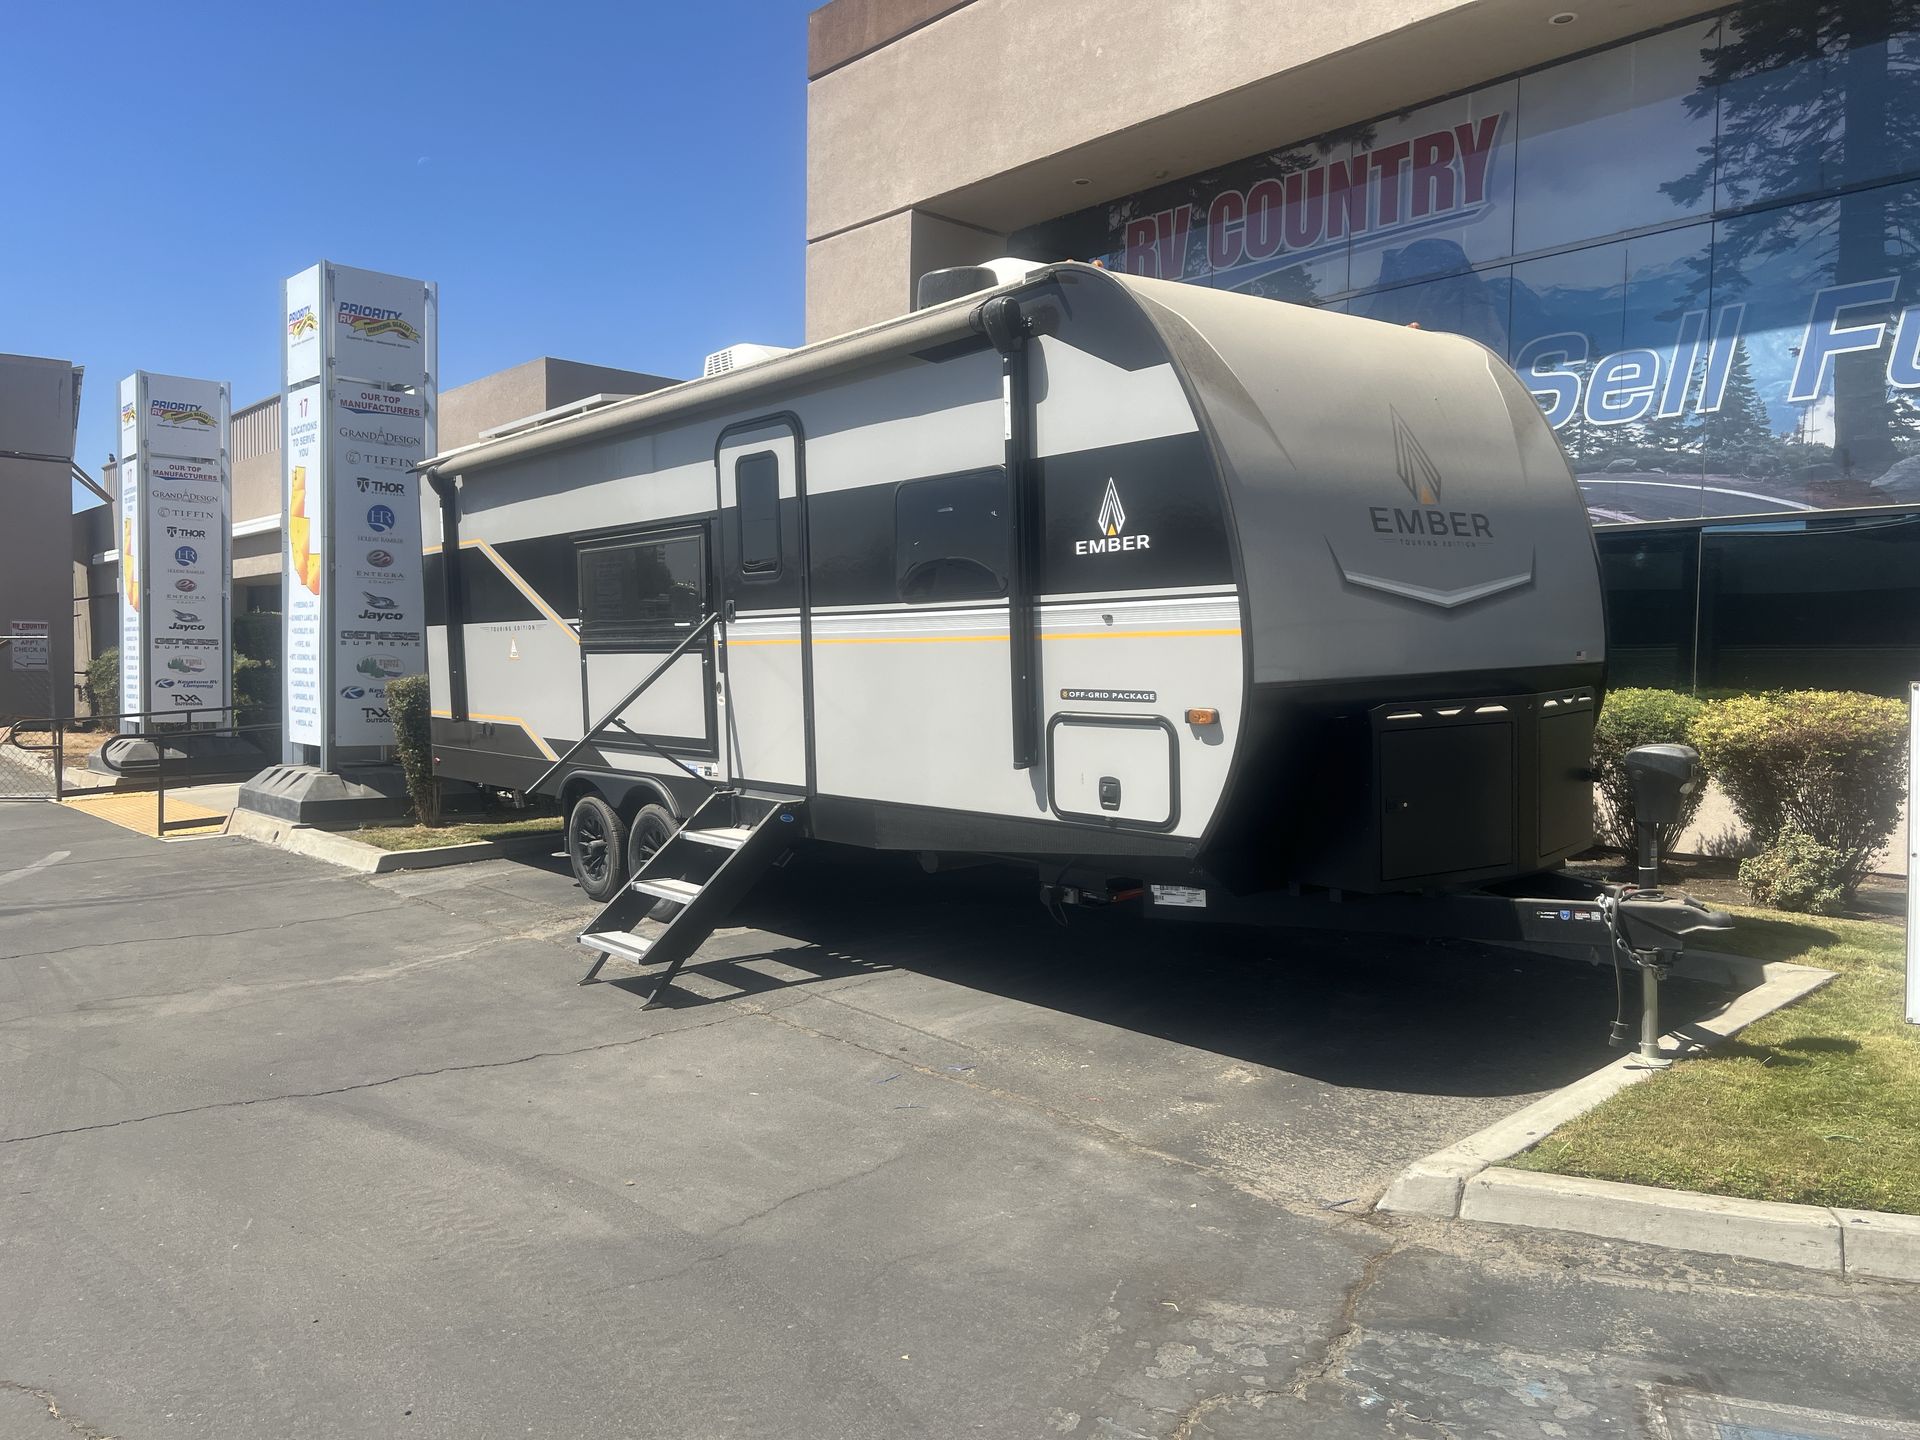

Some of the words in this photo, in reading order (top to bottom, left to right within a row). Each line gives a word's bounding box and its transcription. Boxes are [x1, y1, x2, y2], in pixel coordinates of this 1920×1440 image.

[1126, 203, 1193, 281] RV
[1206, 112, 1502, 271] COUNTRY
[339, 301, 402, 320] PRIORITY
[340, 314, 353, 324] RV
[1514, 303, 1747, 430] Sell
[361, 392, 380, 402] OUR
[383, 395, 401, 404] TOP
[151, 400, 202, 412] PRIORITY
[151, 408, 163, 416] RV
[299, 398, 308, 418] 17
[340, 399, 420, 417] MANUFACTURERS
[340, 427, 378, 441] GRAND
[386, 432, 421, 445] DESIGN
[364, 454, 415, 468] TIFFIN
[152, 469, 218, 481] MANUFACTURERS
[371, 481, 405, 494] THOR
[152, 490, 183, 499] GRAND
[190, 493, 218, 502] DESIGN
[172, 509, 214, 518] TIFFIN
[1368, 506, 1495, 539] EMBER
[179, 529, 206, 538] THOR
[1075, 534, 1151, 556] EMBER
[356, 570, 405, 578] ENTEGRA
[358, 609, 404, 622] Jayco
[168, 622, 206, 632] Jayco
[514, 624, 536, 632] EDITION
[154, 637, 219, 646] GENESIS
[340, 630, 420, 641] GENESIS
[171, 694, 203, 703] TAXA
[1068, 691, 1109, 699] OFF-GRID
[1112, 692, 1155, 701] PACKAGE
[361, 708, 391, 718] TAX
